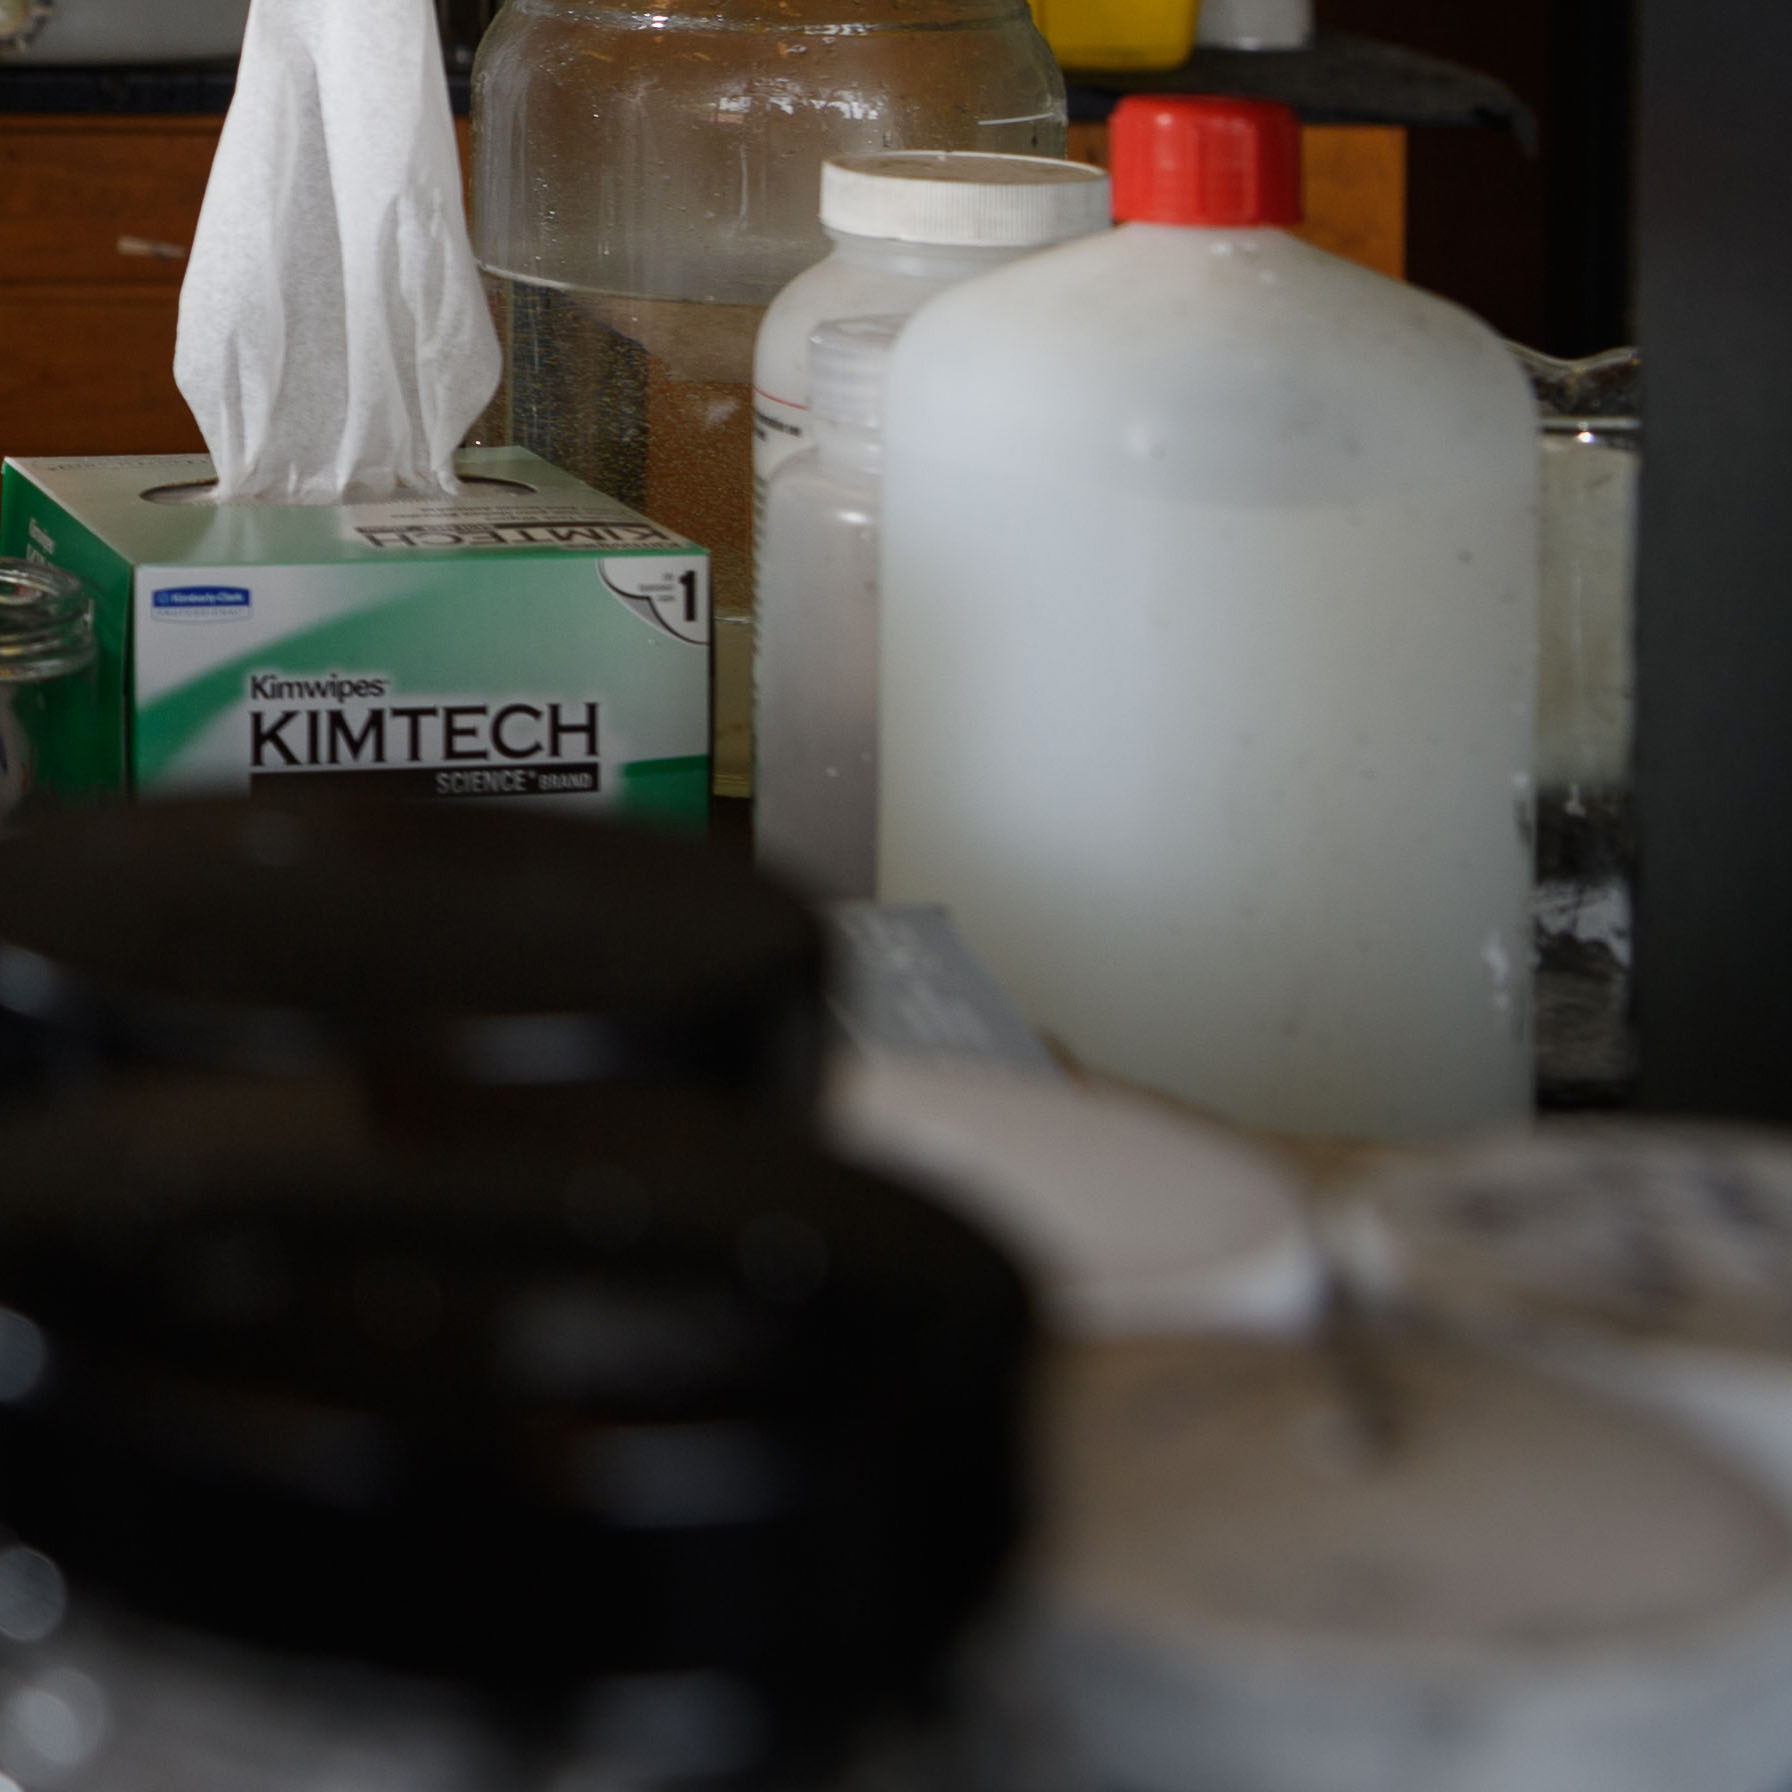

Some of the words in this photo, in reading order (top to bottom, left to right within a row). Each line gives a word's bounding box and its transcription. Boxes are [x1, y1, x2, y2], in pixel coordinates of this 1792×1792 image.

[679, 570, 696, 622] 1
[250, 673, 384, 703] Kimwipes
[250, 702, 598, 766] KIMTECH
[436, 771, 527, 794] SCIENCE
[538, 773, 591, 790] BRAND
